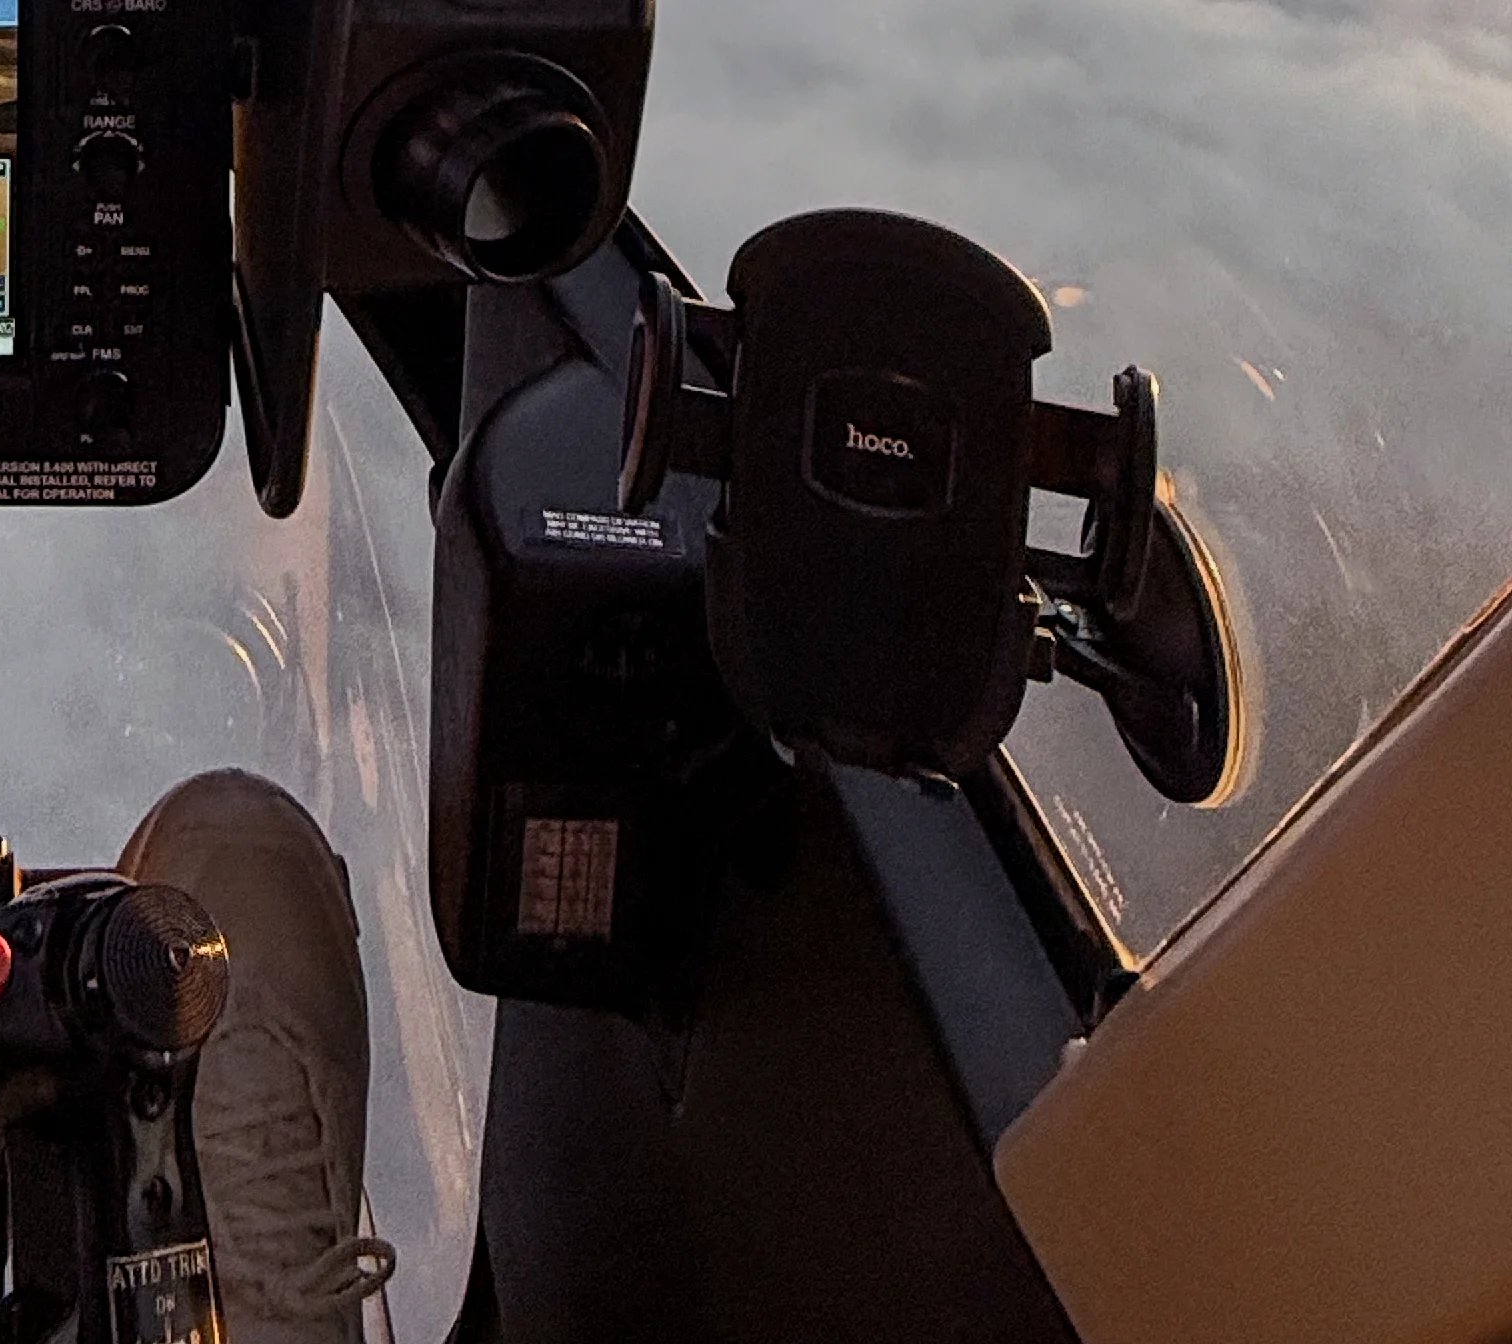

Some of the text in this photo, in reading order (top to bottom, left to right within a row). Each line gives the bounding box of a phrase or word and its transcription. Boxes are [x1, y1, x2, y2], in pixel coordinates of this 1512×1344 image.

[83, 115, 136, 129] RANGE
[93, 212, 124, 225] PAN
[92, 348, 122, 361] FMS
[76, 461, 109, 473] WITH
[111, 461, 157, 473] DIRECT
[94, 475, 136, 487] REFER
[139, 475, 156, 487] TO
[13, 488, 39, 500] FOR
[42, 488, 115, 500] OPERATION
[112, 1258, 162, 1291] ATTD
